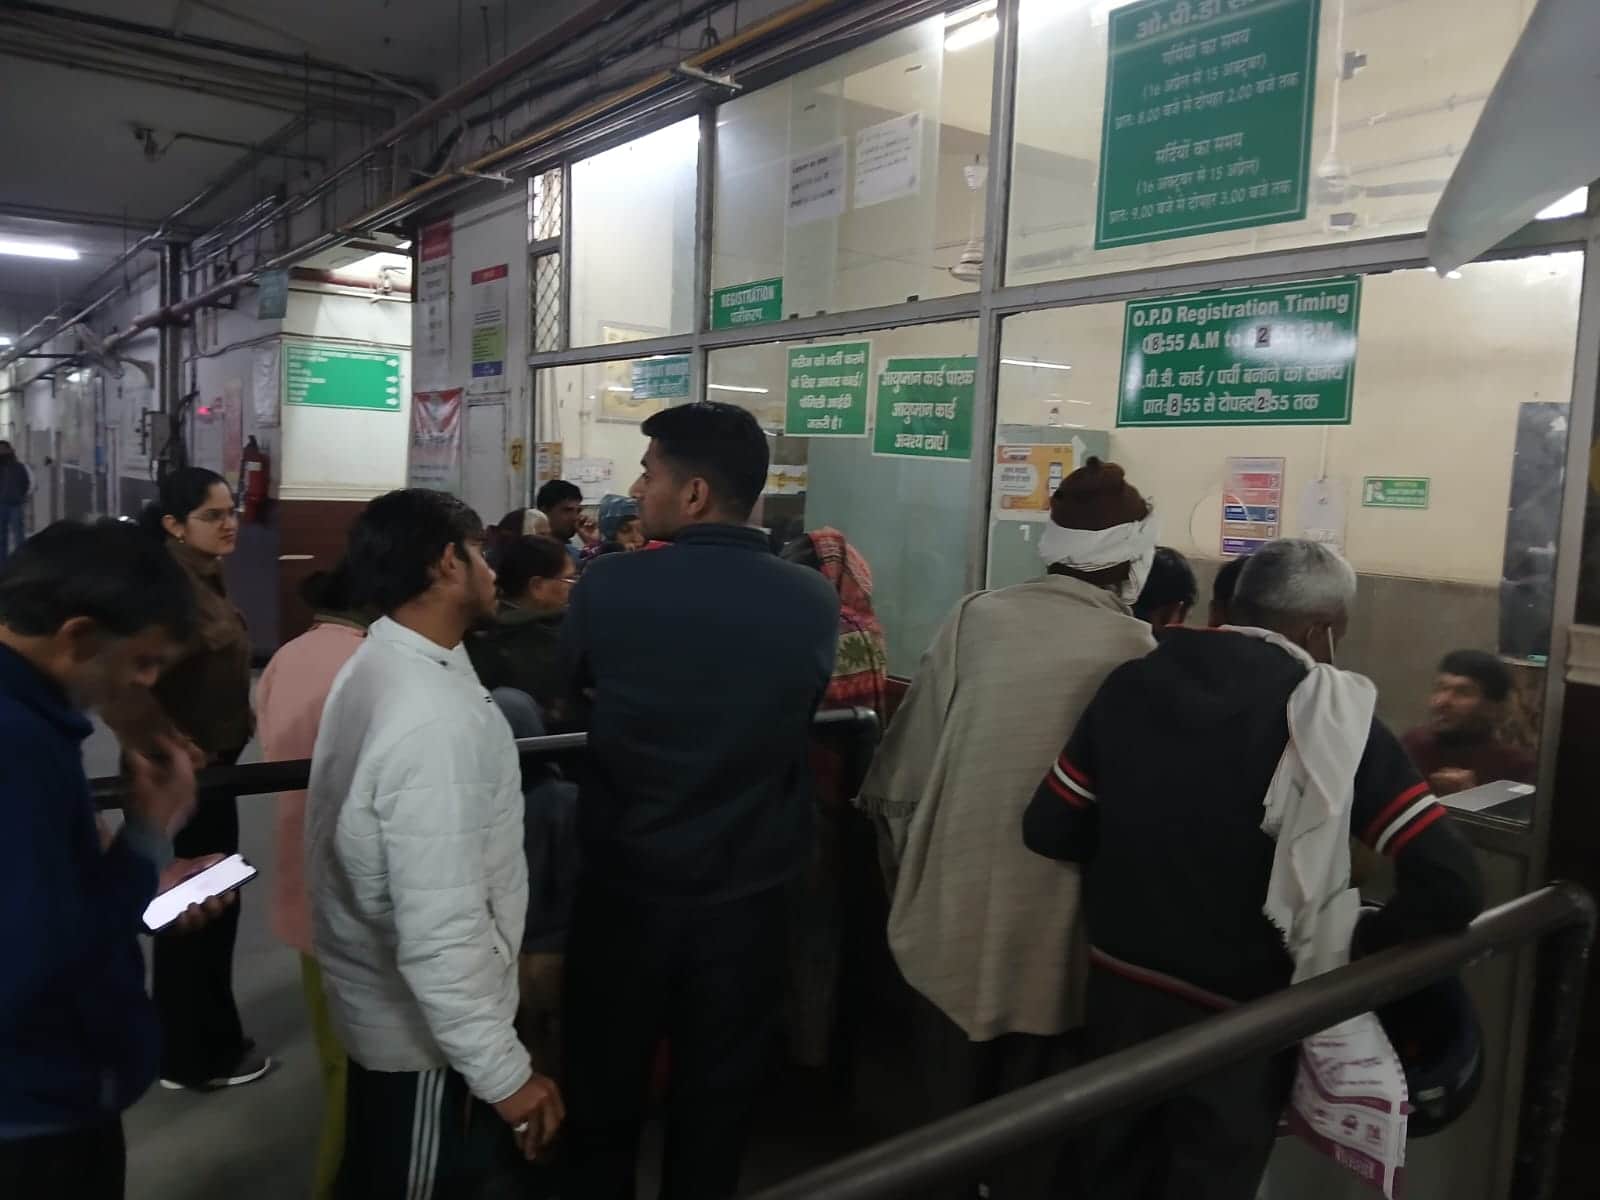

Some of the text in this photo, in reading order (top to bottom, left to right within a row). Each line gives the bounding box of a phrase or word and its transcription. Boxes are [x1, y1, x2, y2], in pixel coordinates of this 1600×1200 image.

[1206, 68, 1218, 81] 15
[1211, 167, 1224, 180] 15
[1133, 291, 1349, 327] O.P.D Registration Timing
[1188, 331, 1219, 350] A.M
[1225, 331, 1241, 346] to
[923, 365, 946, 386] कार्ड
[1179, 365, 1205, 386] कार्ड
[1218, 363, 1240, 384] पर्ची
[934, 398, 957, 420] कार्ड
[1204, 392, 1215, 412] से
[1293, 393, 1320, 411] तक
